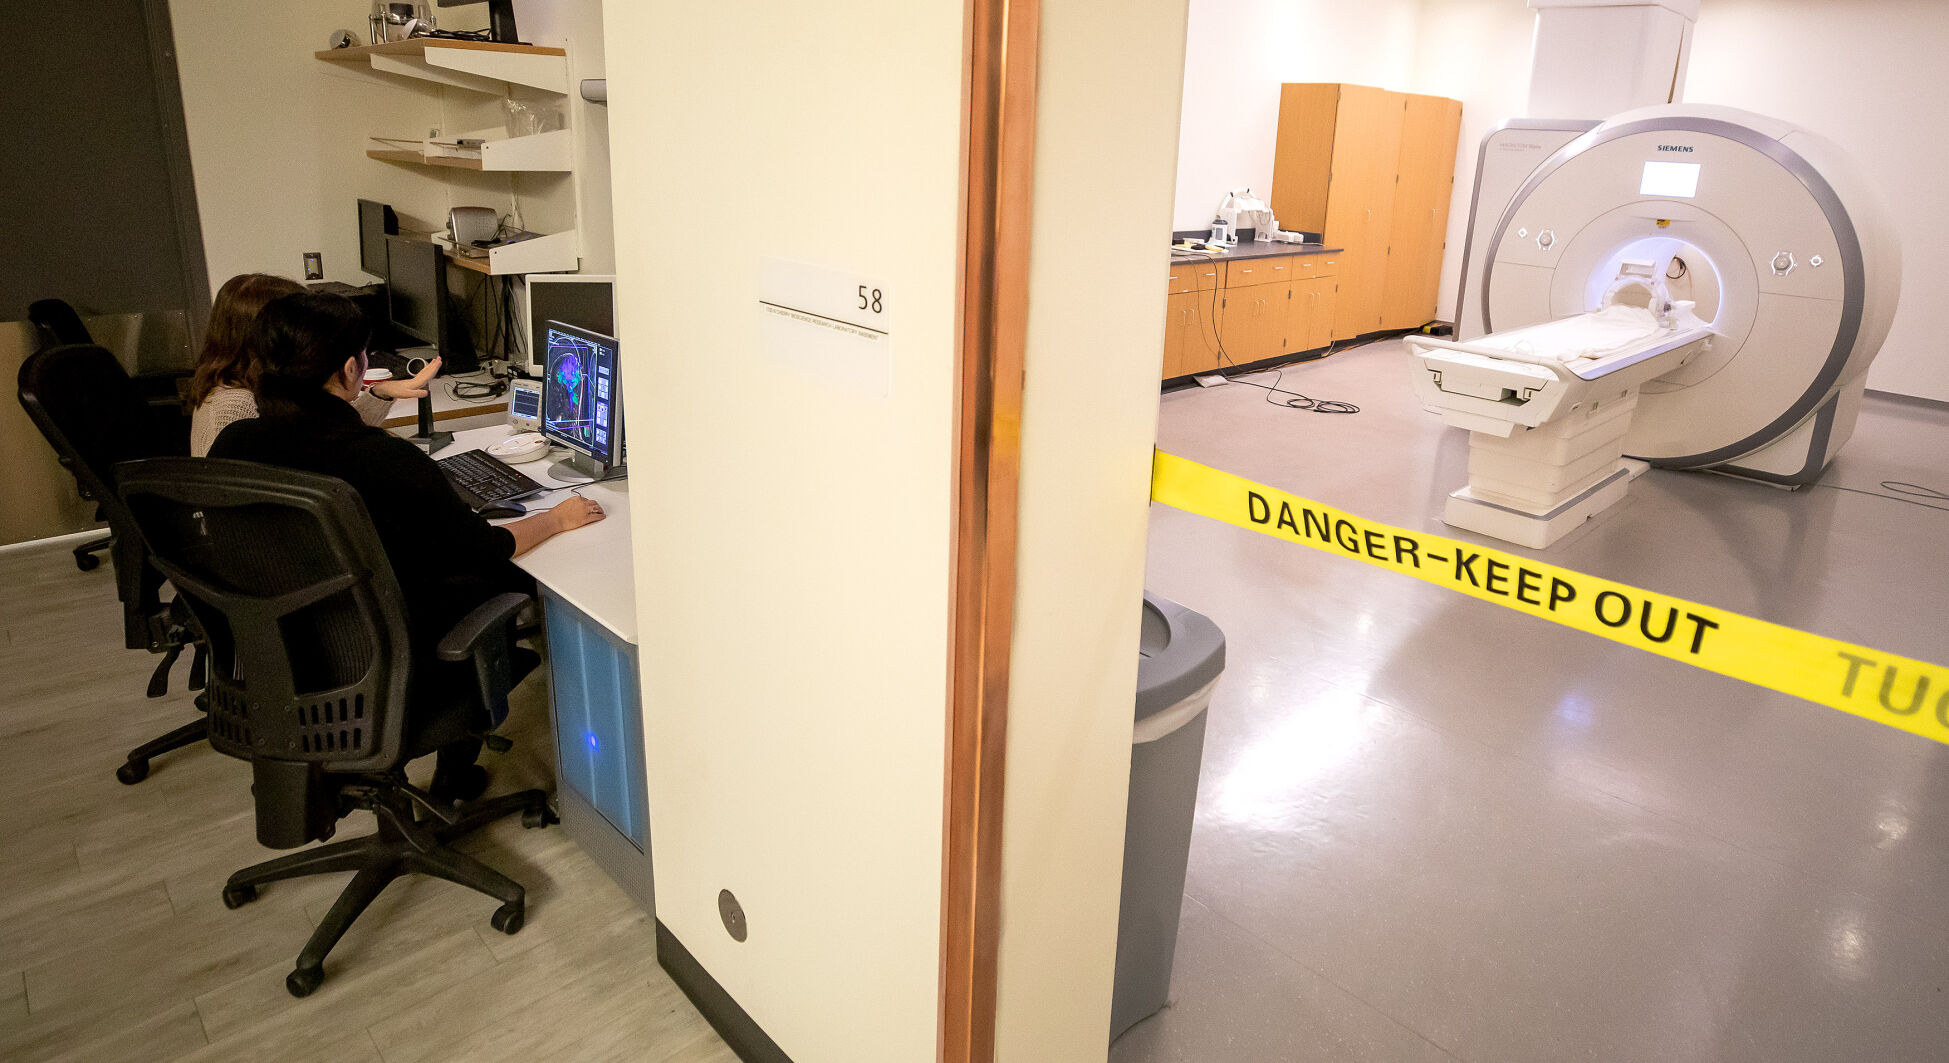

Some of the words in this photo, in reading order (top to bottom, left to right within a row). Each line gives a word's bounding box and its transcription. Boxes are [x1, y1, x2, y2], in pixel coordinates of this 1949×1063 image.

[1657, 145, 1694, 153] SIEMENS
[858, 285, 882, 314] 58
[1594, 590, 1720, 655] OUT
